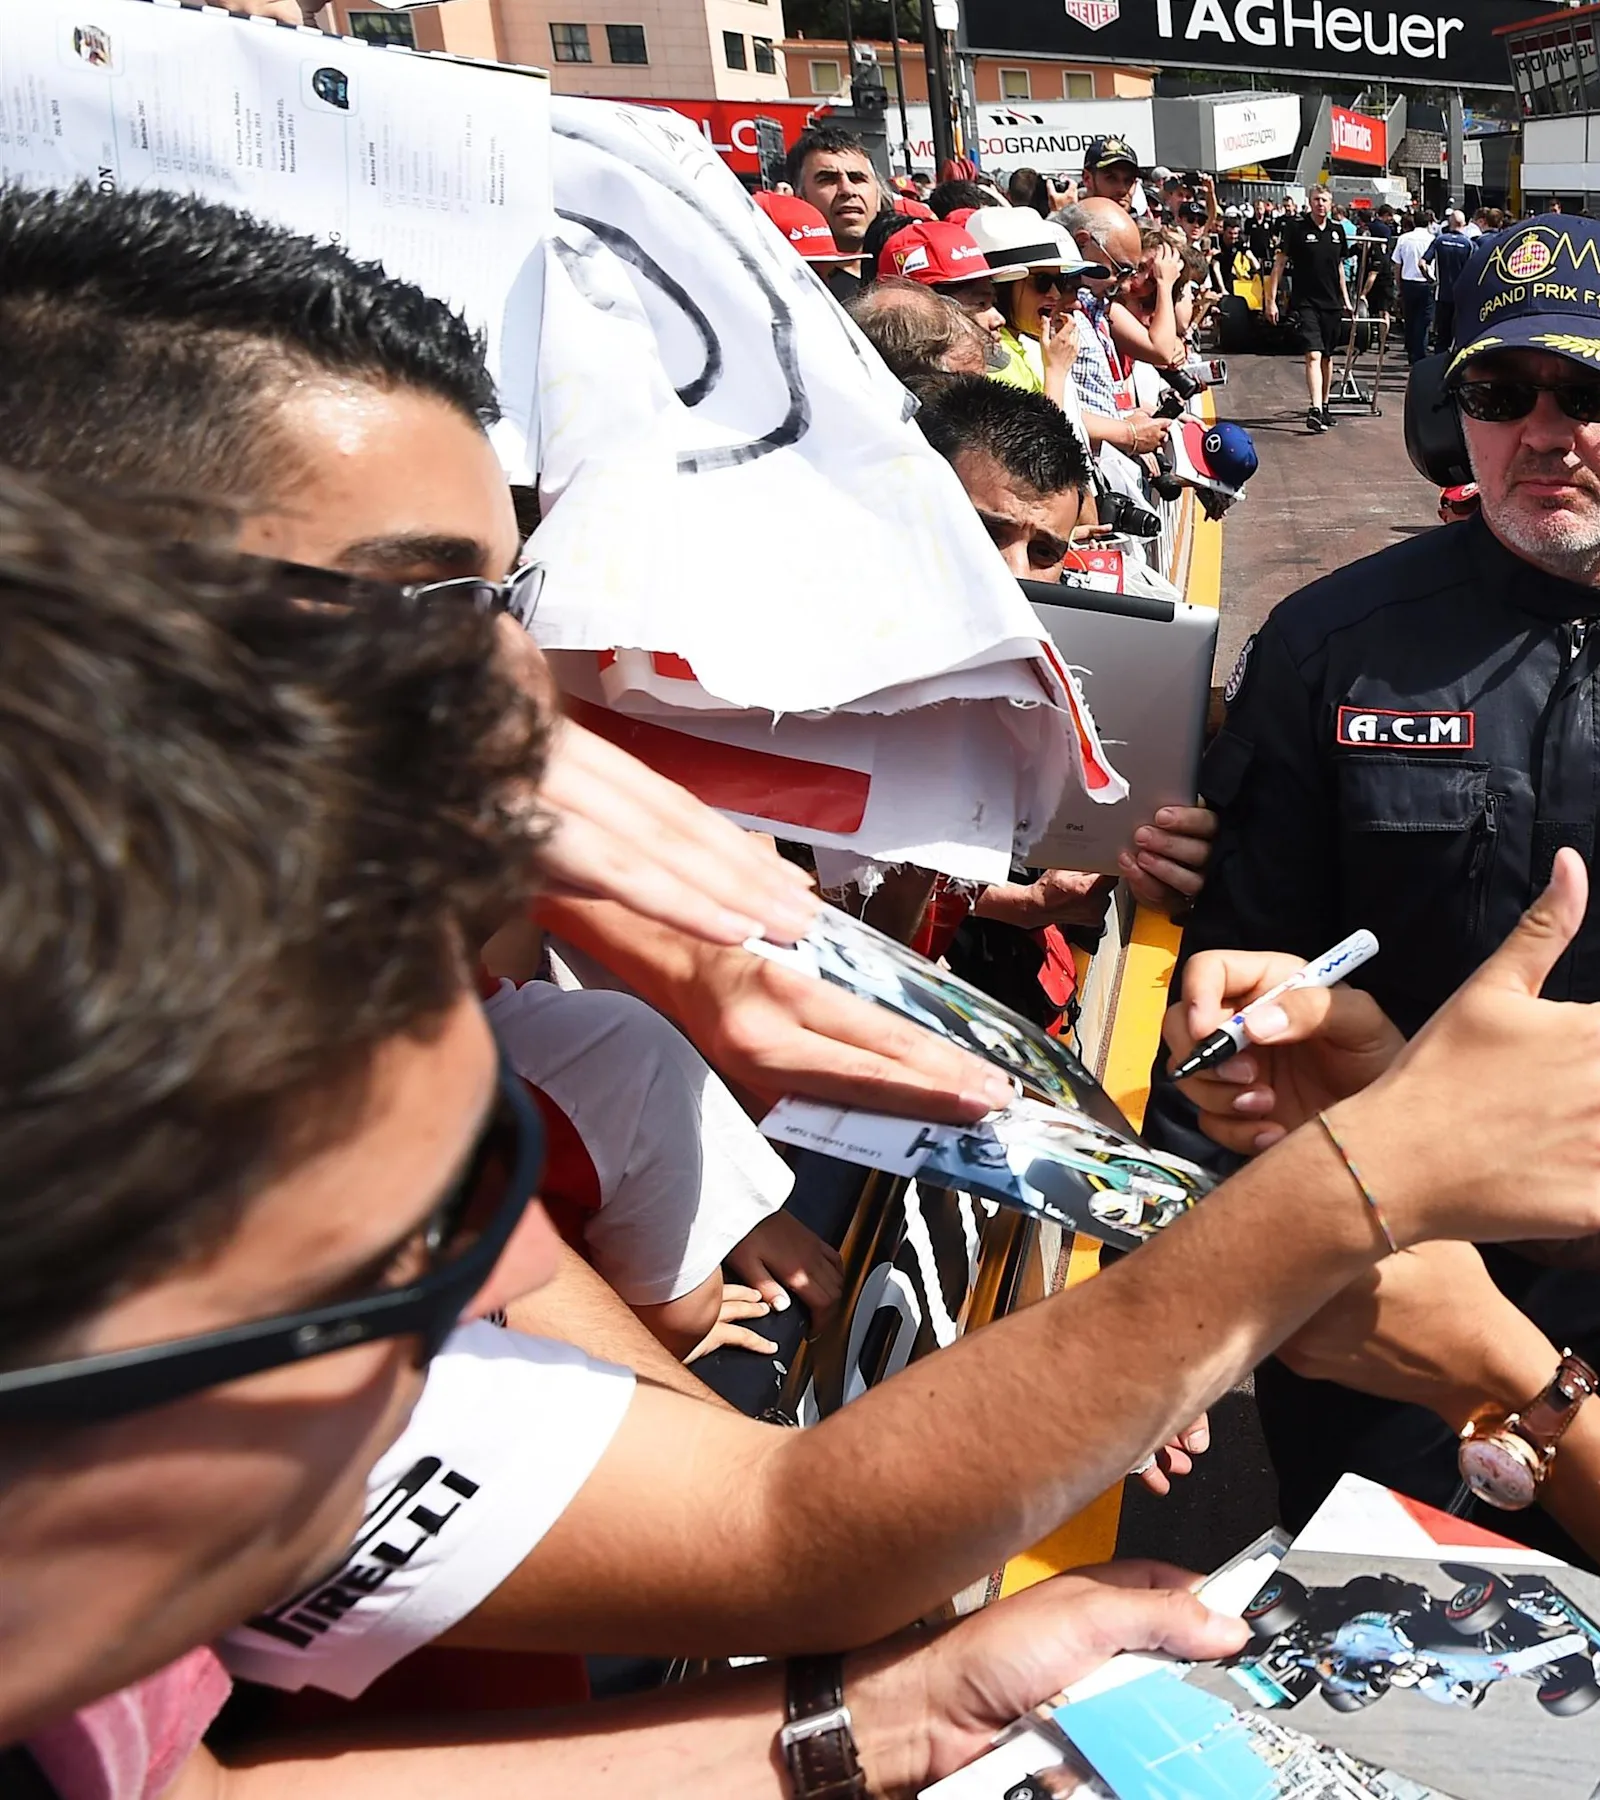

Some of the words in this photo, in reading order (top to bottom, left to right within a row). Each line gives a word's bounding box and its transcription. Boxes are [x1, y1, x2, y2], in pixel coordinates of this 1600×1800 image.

[1067, 1, 1117, 26] HEUER
[1479, 286, 1526, 322] GRAND
[1533, 284, 1578, 303] PRIX
[245, 1456, 480, 1650] PIRELLI
